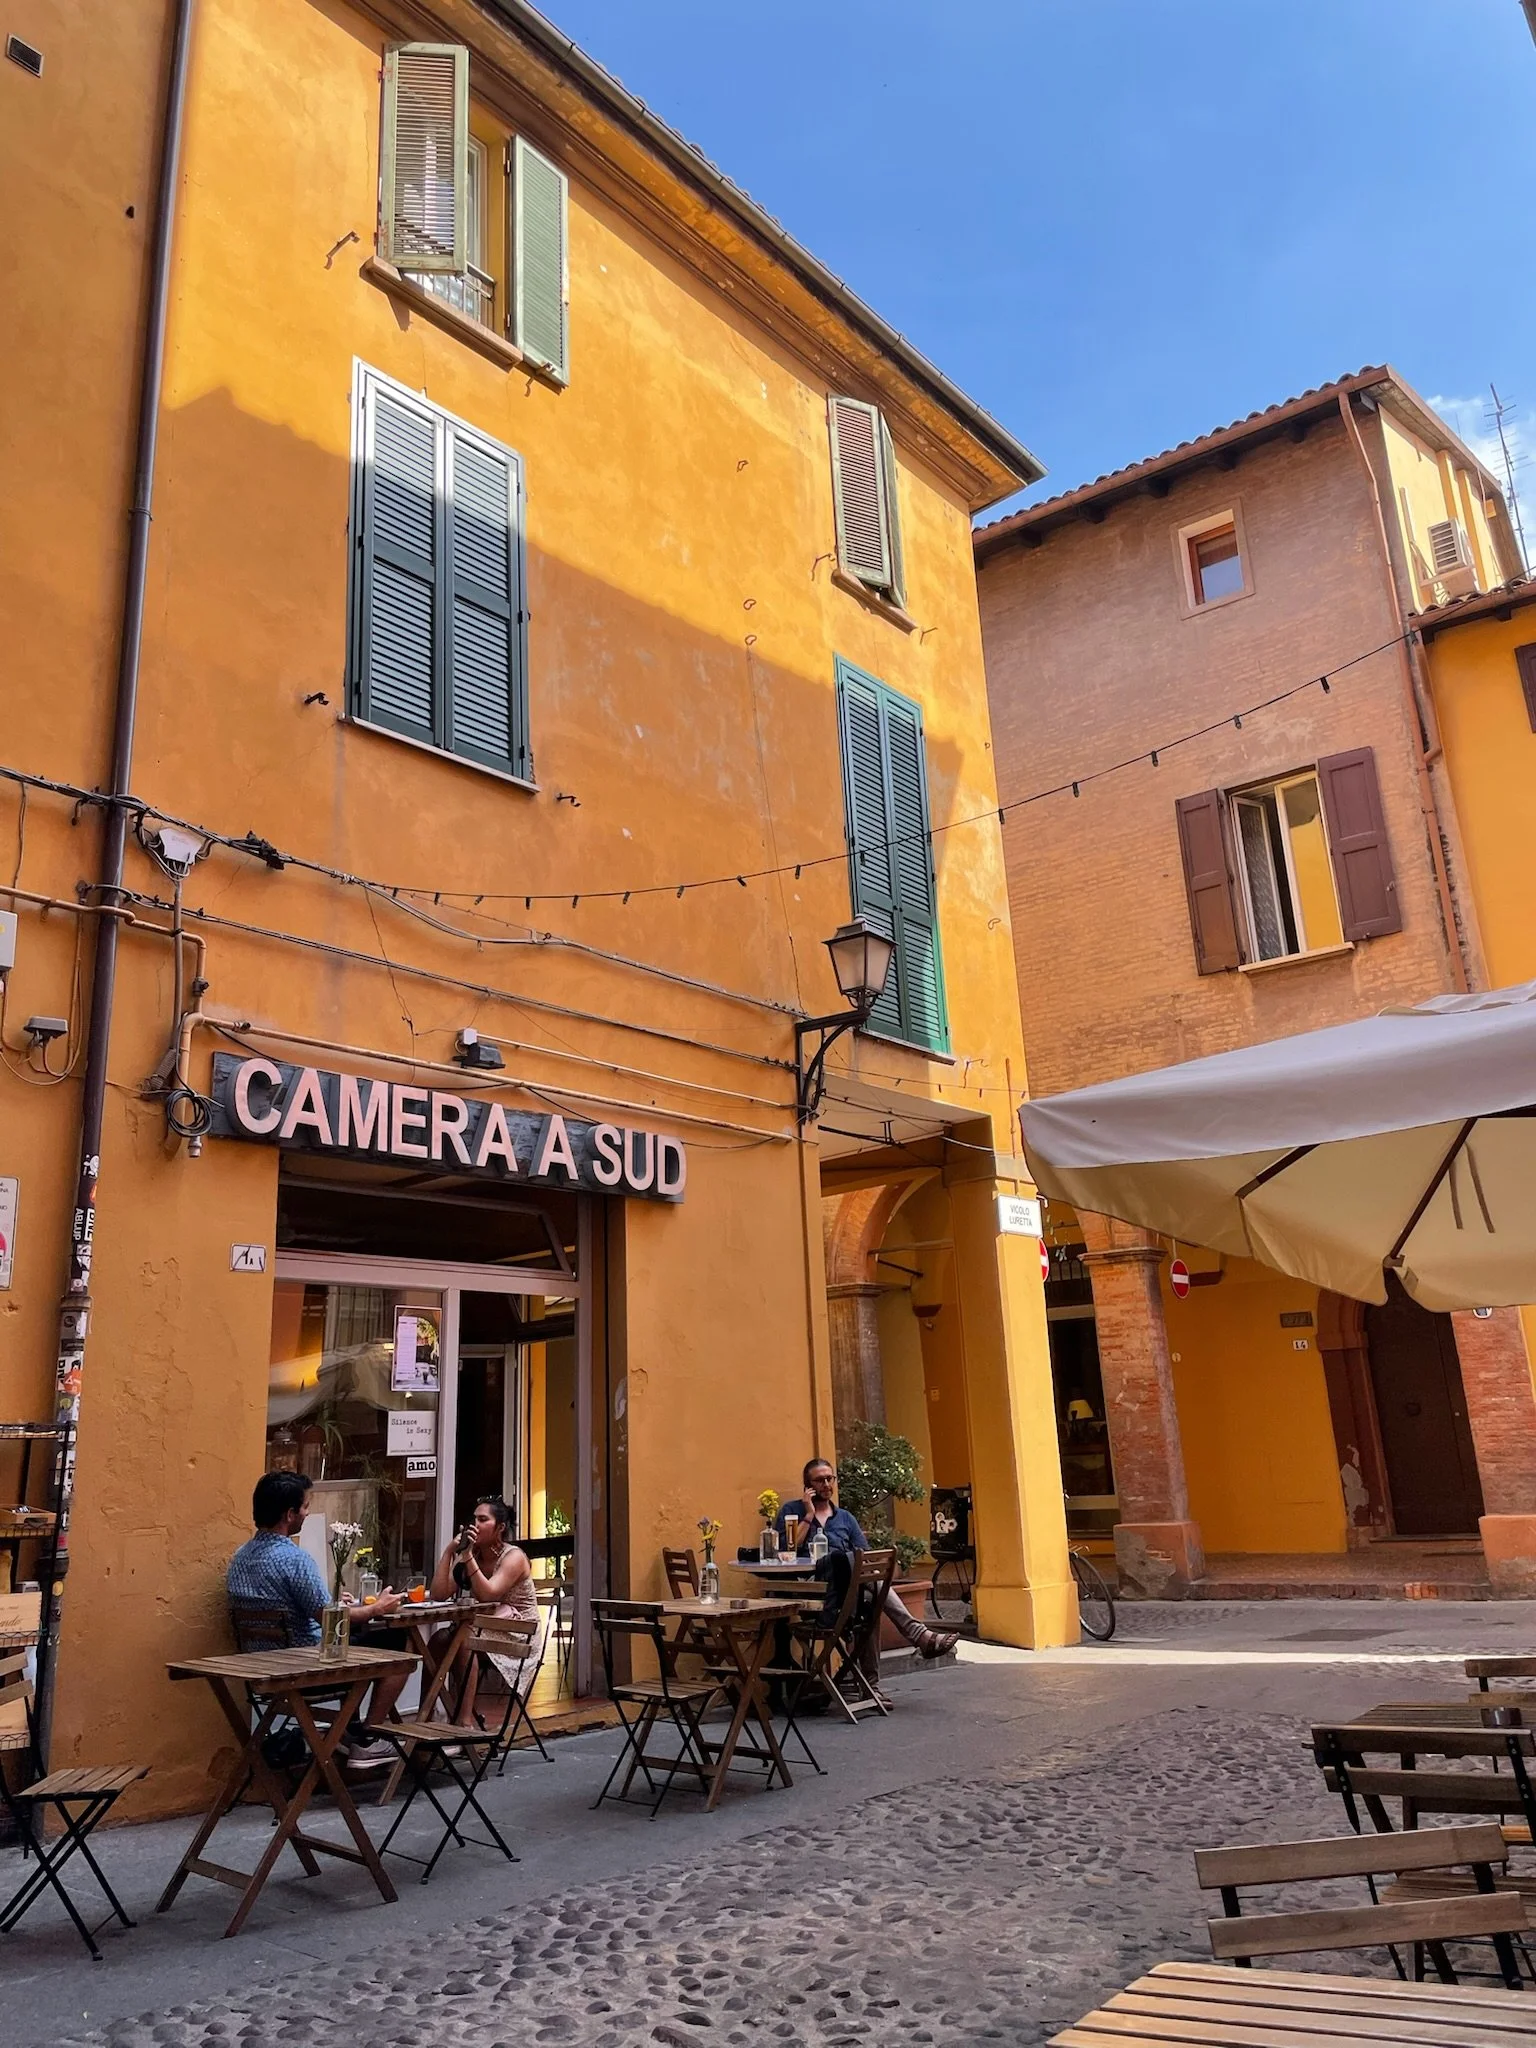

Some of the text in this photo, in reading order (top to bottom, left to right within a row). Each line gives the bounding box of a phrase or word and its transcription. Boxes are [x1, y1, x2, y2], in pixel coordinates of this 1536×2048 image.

[231, 1057, 688, 1196] CAMERA A SUD
[1009, 1204, 1030, 1215] VICOLO
[1009, 1216, 1033, 1227] LURETTA
[391, 1418, 418, 1426] Silence
[415, 1426, 432, 1436] Sexy
[407, 1461, 436, 1472] amo
